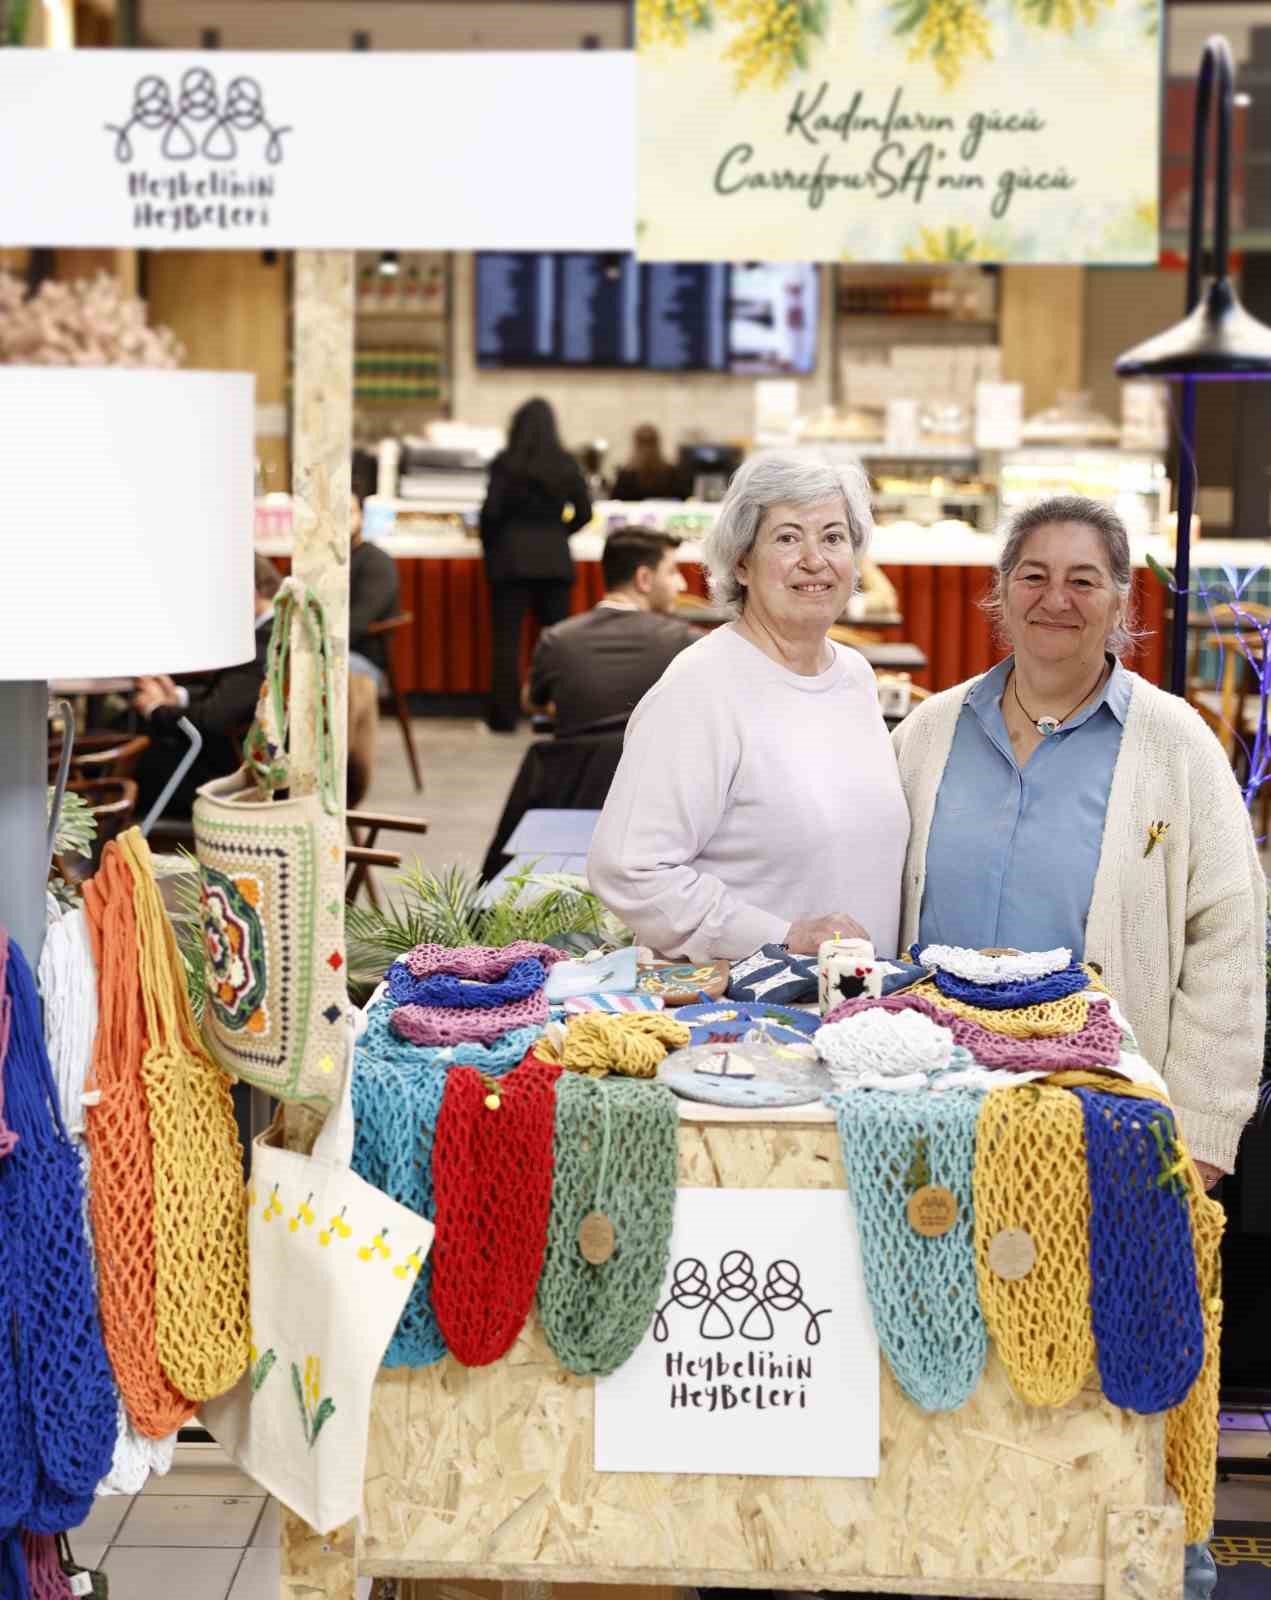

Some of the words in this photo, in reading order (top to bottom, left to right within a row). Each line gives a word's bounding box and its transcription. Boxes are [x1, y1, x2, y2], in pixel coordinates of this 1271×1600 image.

[784, 81, 955, 144] Kadınların
[959, 109, 1046, 162] gücü
[713, 142, 986, 211] CarrefourSA'nın
[989, 167, 1077, 219] gücü
